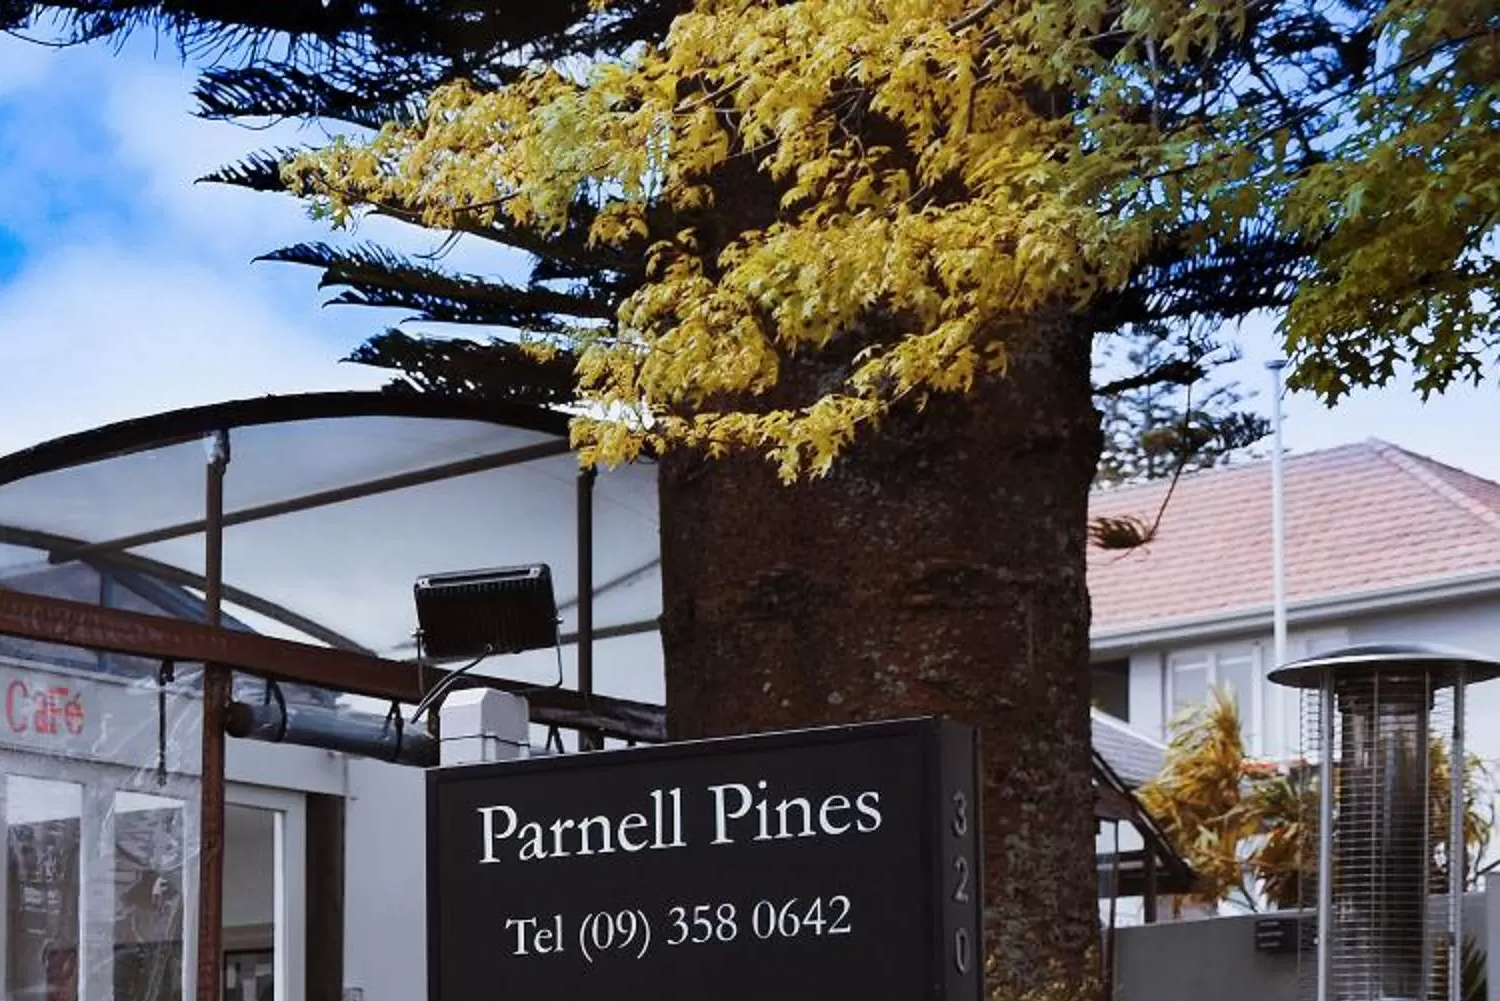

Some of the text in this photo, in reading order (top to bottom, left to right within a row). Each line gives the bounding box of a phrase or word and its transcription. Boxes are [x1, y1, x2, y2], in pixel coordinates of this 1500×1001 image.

[477, 780, 883, 864] Parnell Pines
[505, 894, 852, 963] Tel (09) 358 0642
